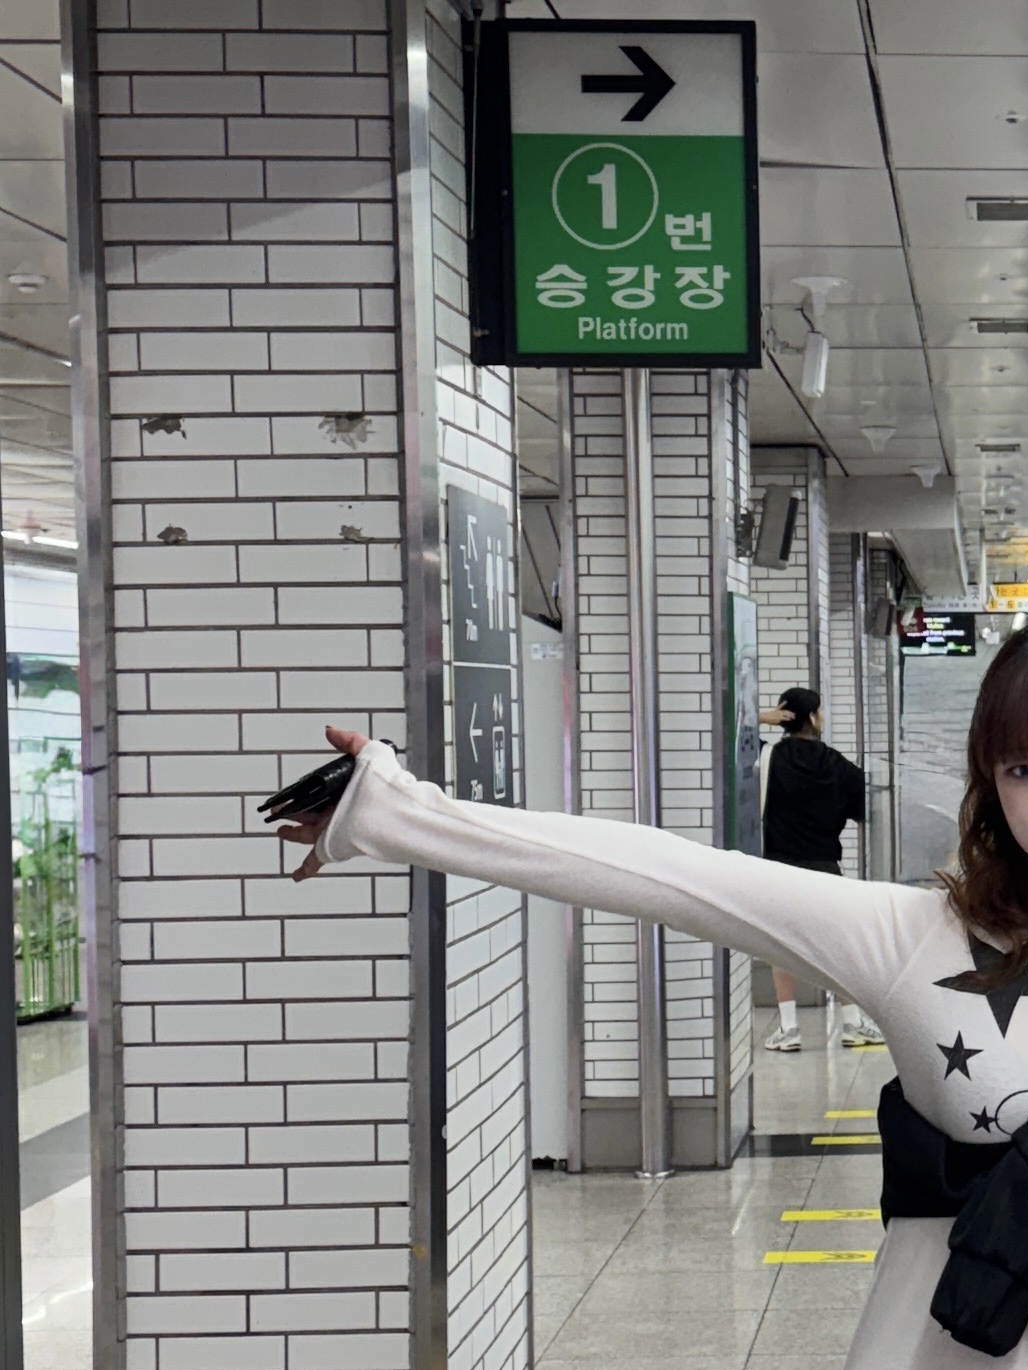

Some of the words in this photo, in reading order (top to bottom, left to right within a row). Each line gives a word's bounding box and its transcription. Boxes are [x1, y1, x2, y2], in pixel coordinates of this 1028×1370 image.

[587, 163, 618, 230] 1
[664, 212, 712, 251] 번
[535, 264, 731, 309] 승강장
[578, 316, 689, 340] Platform
